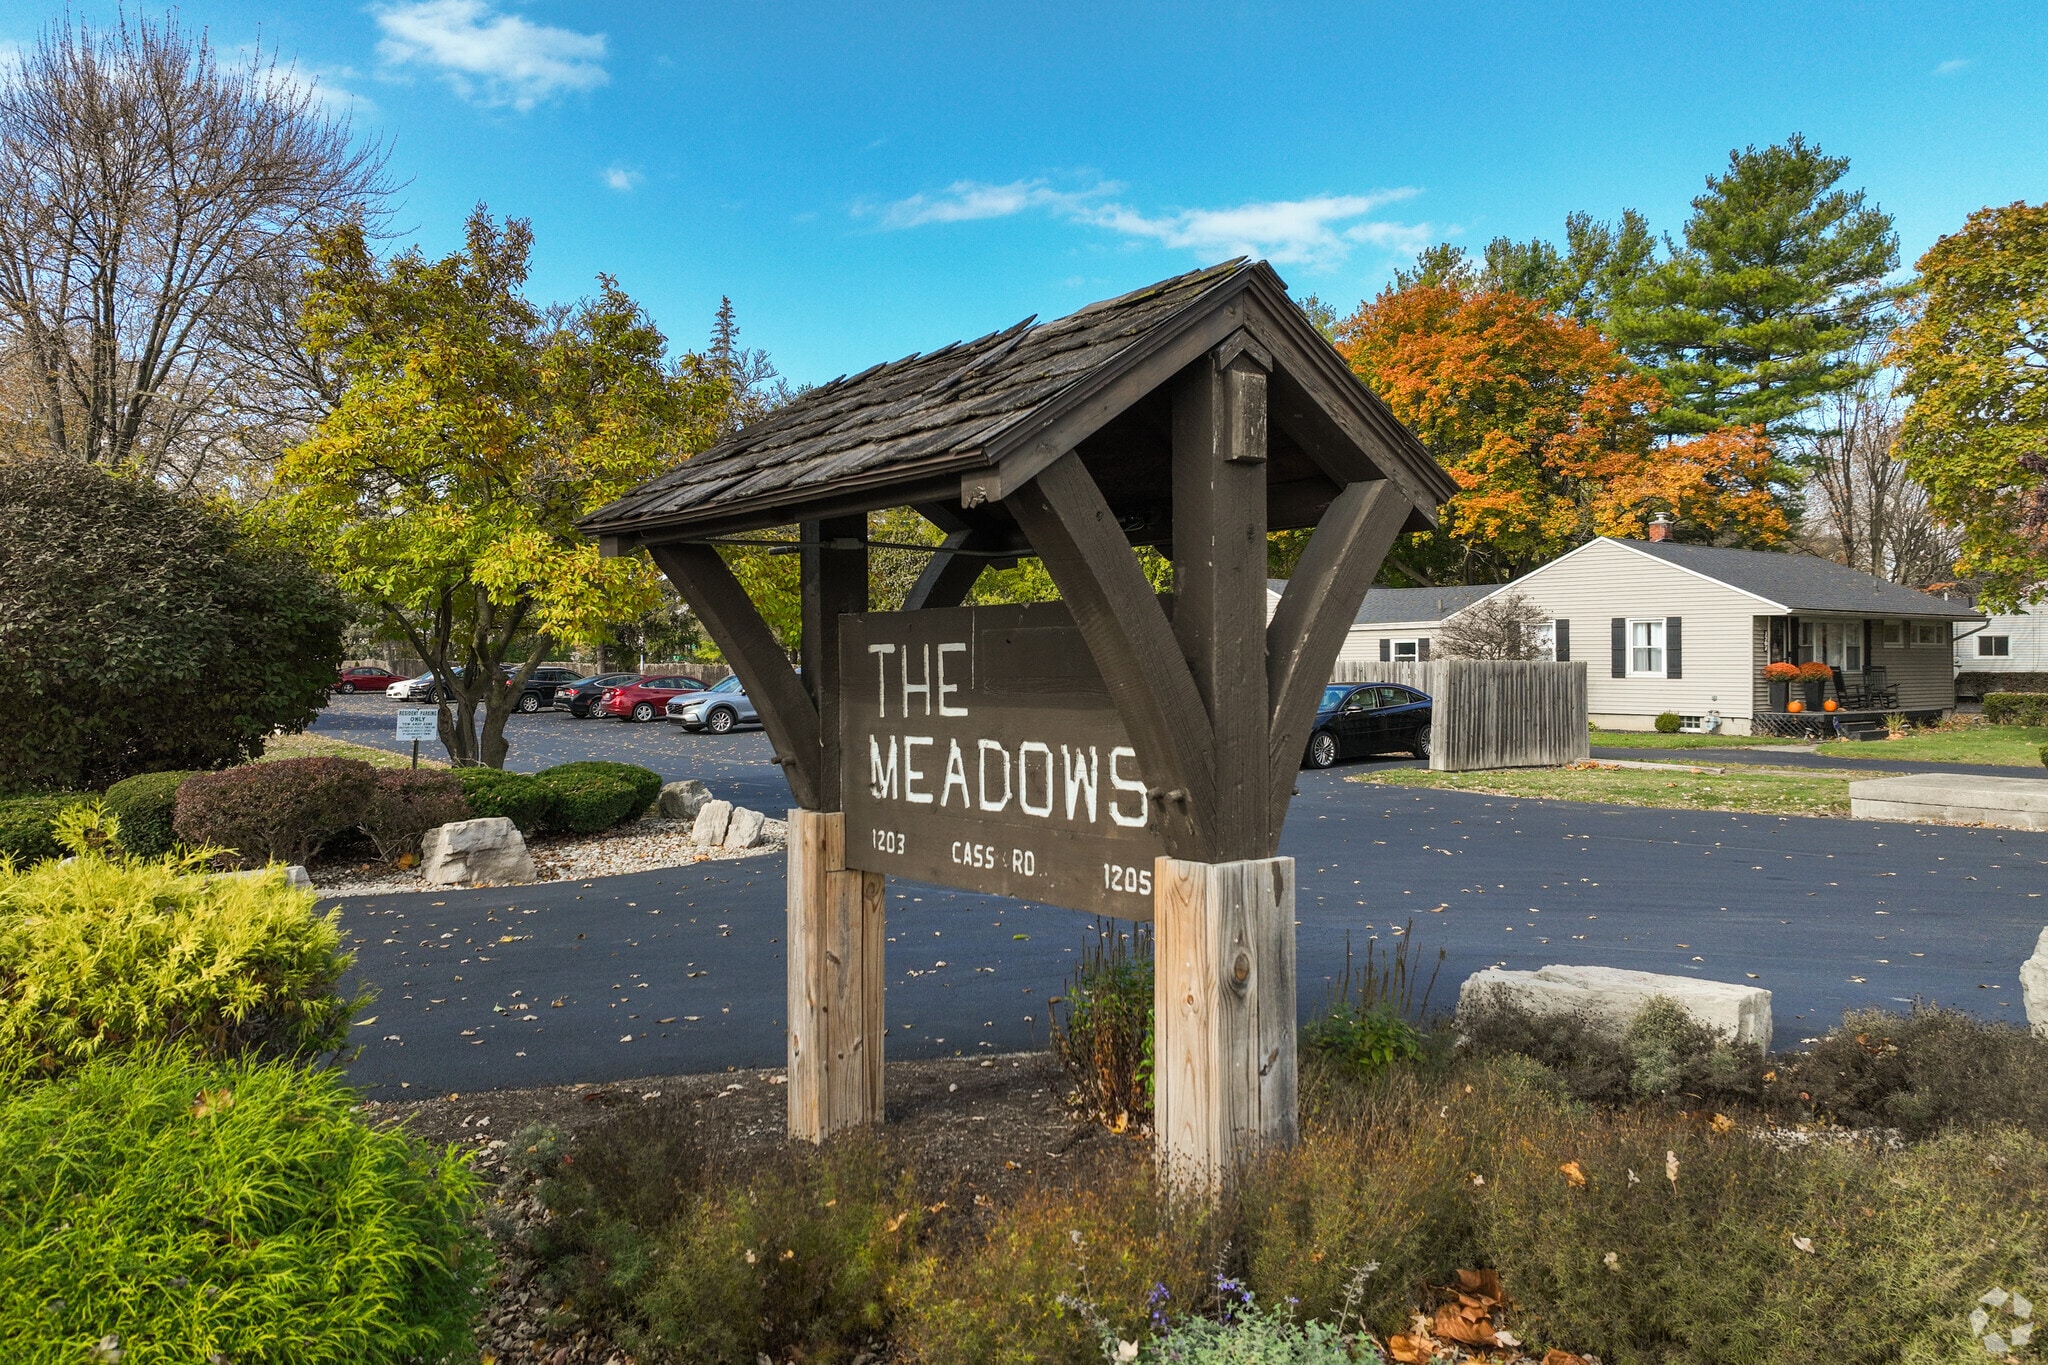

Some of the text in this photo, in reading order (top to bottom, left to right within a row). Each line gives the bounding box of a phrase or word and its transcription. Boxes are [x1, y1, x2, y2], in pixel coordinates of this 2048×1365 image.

[868, 642, 968, 718] THE
[869, 734, 1149, 828] MEADOWS
[872, 829, 1152, 896] 1203 CASS RD 1205
